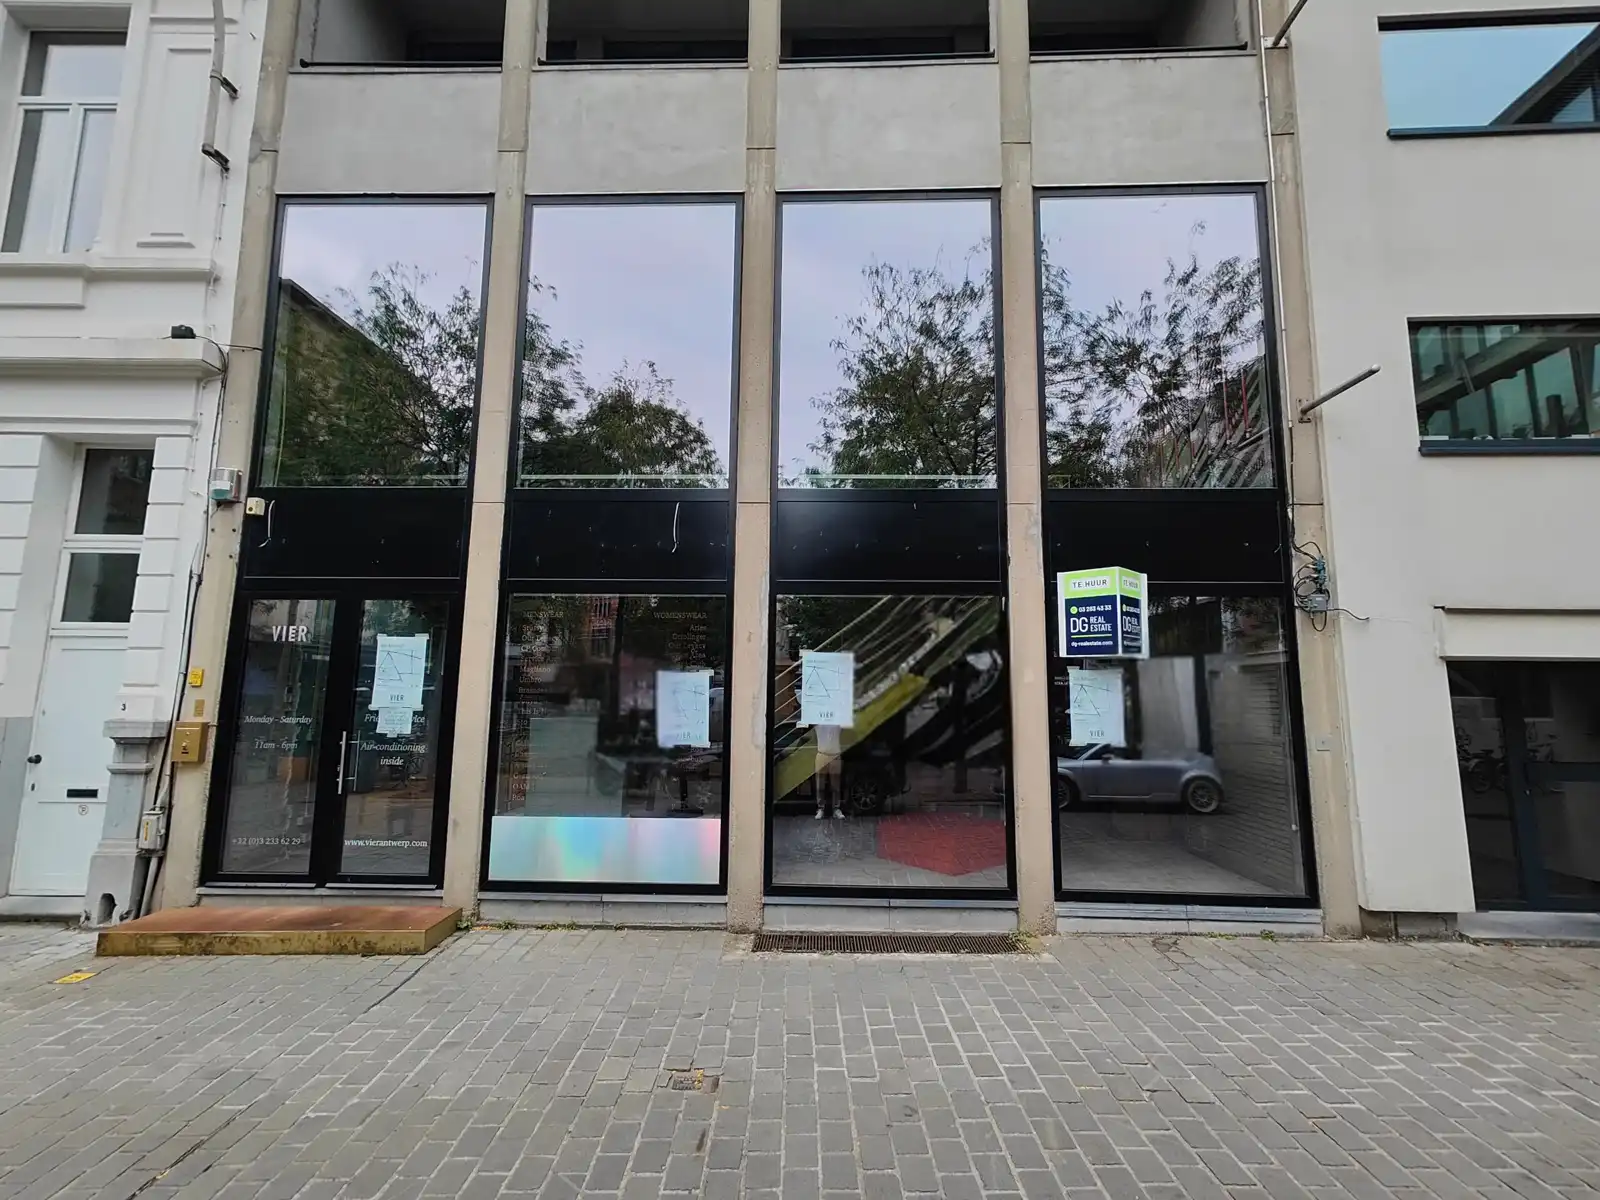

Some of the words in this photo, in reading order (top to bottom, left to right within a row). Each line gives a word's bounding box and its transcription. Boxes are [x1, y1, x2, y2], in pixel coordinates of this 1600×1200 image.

[1072, 581, 1083, 589] TE
[1085, 578, 1107, 587] HUUR
[1070, 617, 1088, 633] DG
[1090, 616, 1105, 624] REAL
[1090, 623, 1112, 632] ESTATE
[272, 625, 308, 642] VIER
[244, 714, 275, 725] Monday
[280, 714, 313, 726] Saturday
[254, 740, 275, 750] 11am
[281, 740, 298, 751] 6pm
[360, 741, 426, 754] Air-conditioning
[380, 756, 404, 766] inside
[344, 837, 428, 848] www.vierantwerp.com
